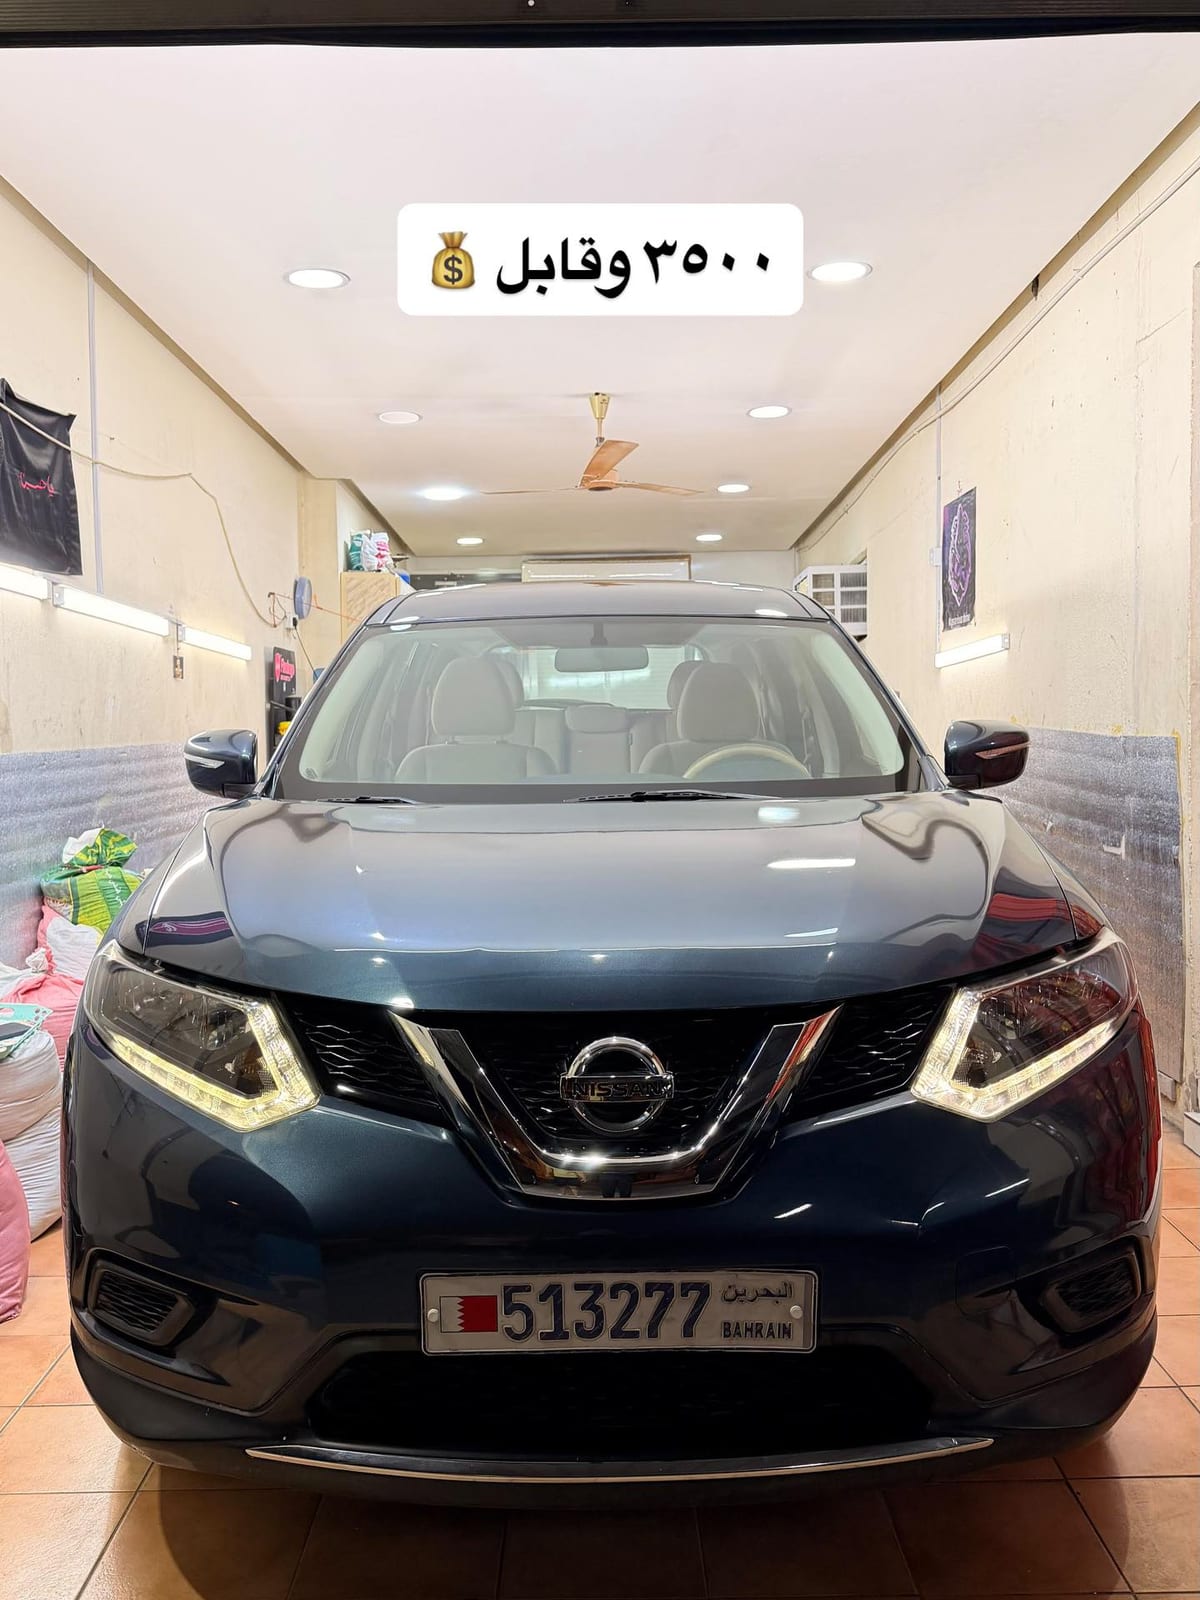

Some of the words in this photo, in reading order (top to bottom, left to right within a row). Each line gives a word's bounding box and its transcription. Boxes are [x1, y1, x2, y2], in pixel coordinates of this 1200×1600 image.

[572, 1081, 661, 1098] NISSAN
[720, 1280, 794, 1305] البحرين
[502, 1281, 713, 1342] 513277
[722, 1320, 793, 1340] BAHRAIN
